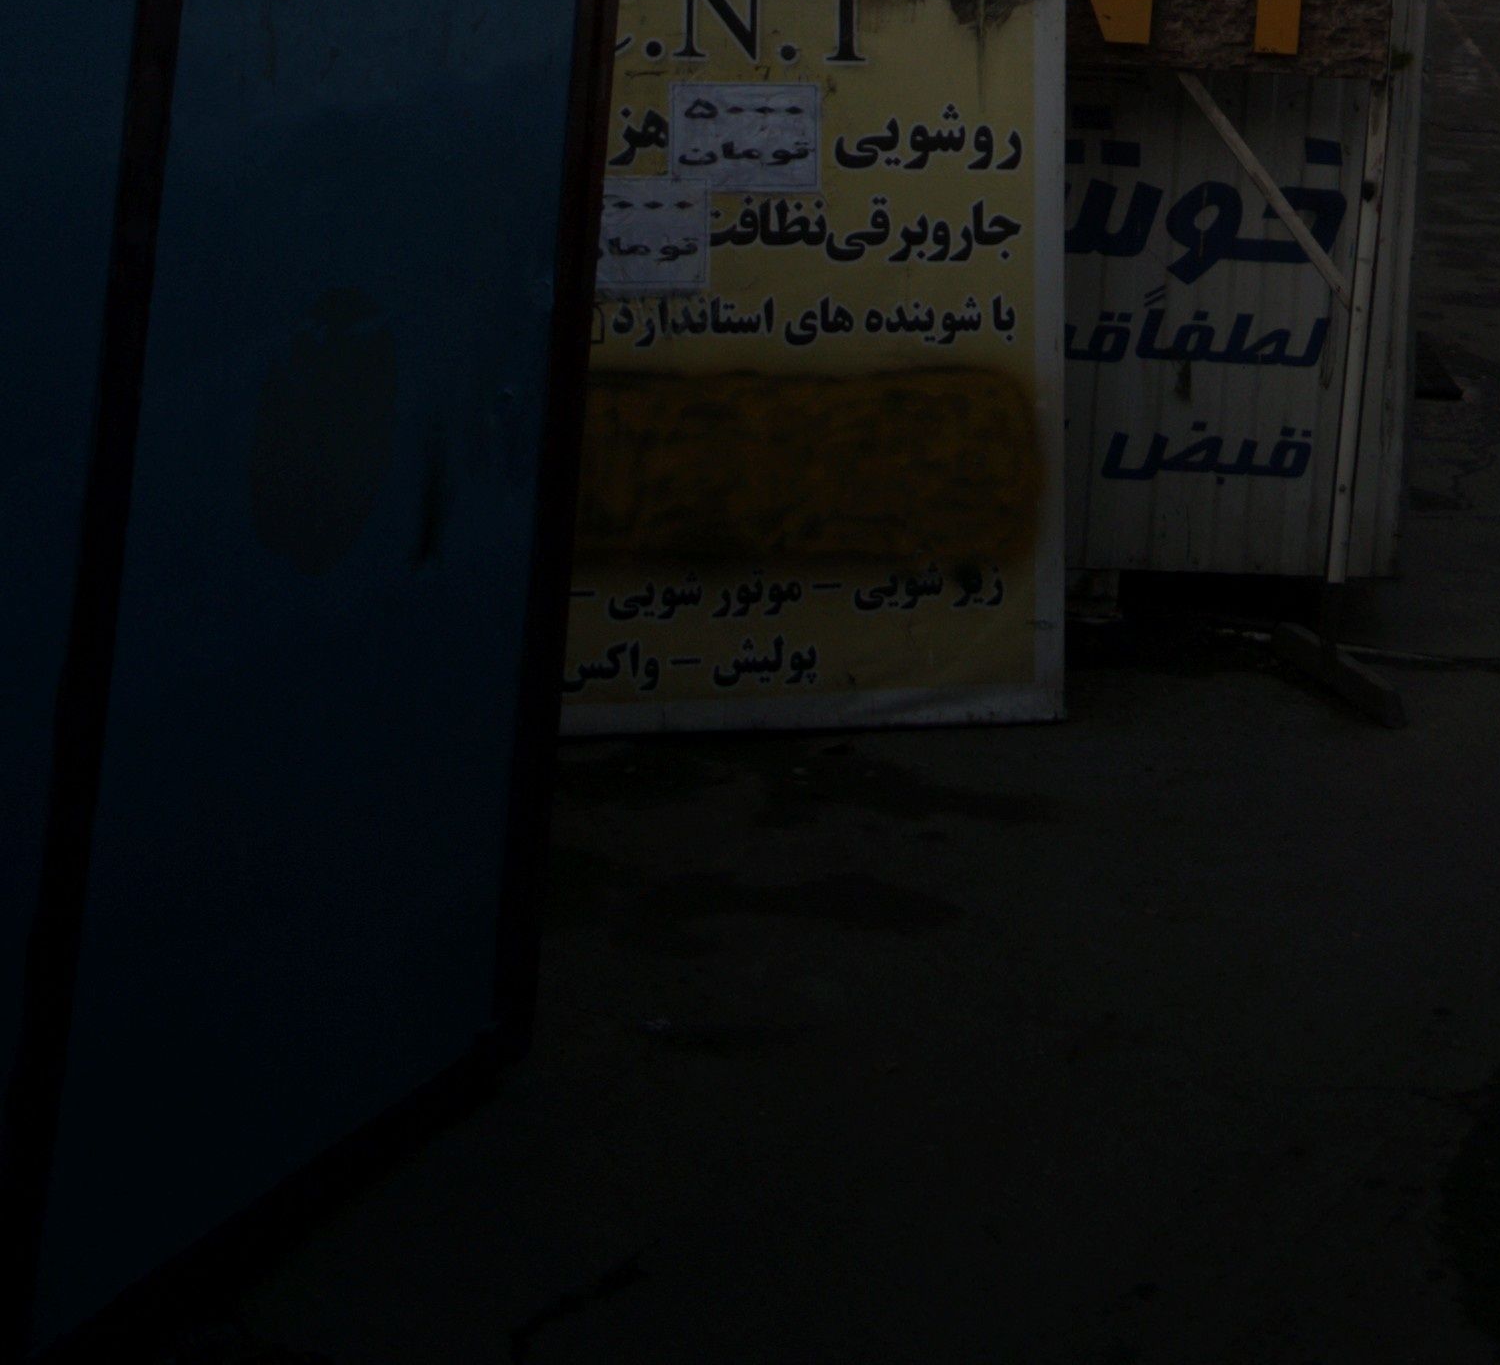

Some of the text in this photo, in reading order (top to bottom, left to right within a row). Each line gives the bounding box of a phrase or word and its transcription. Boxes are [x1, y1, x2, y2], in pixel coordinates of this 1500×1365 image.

[679, 141, 810, 166] تومان
[602, 236, 698, 262] توما
[785, 297, 854, 346] های
[865, 298, 981, 343] شوینده
[993, 295, 1015, 342] با
[1102, 422, 1312, 486] قبض
[712, 568, 802, 618] موتور
[559, 641, 660, 694] واکس
[714, 636, 817, 687] پولیش
